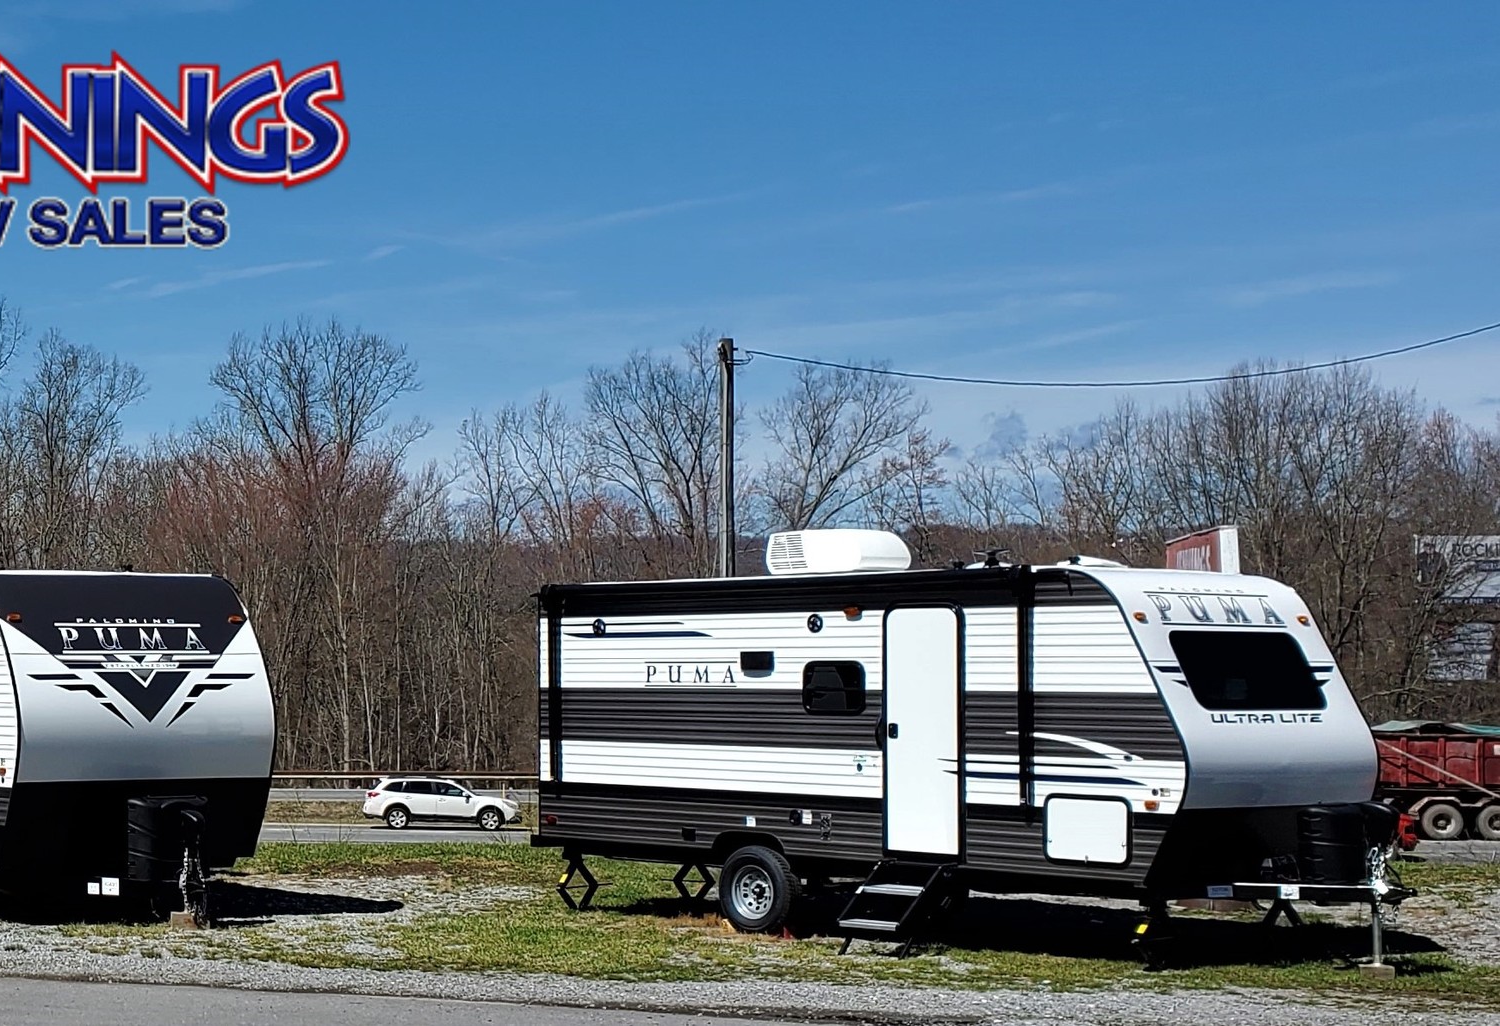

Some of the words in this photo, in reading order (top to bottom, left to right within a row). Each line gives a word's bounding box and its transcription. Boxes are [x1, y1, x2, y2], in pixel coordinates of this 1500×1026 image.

[1147, 594, 1286, 624] PUMA
[58, 627, 206, 649] PUMA
[646, 665, 736, 683] PUMA
[1210, 713, 1275, 724] ULTRA
[1279, 713, 1323, 723] LITE
